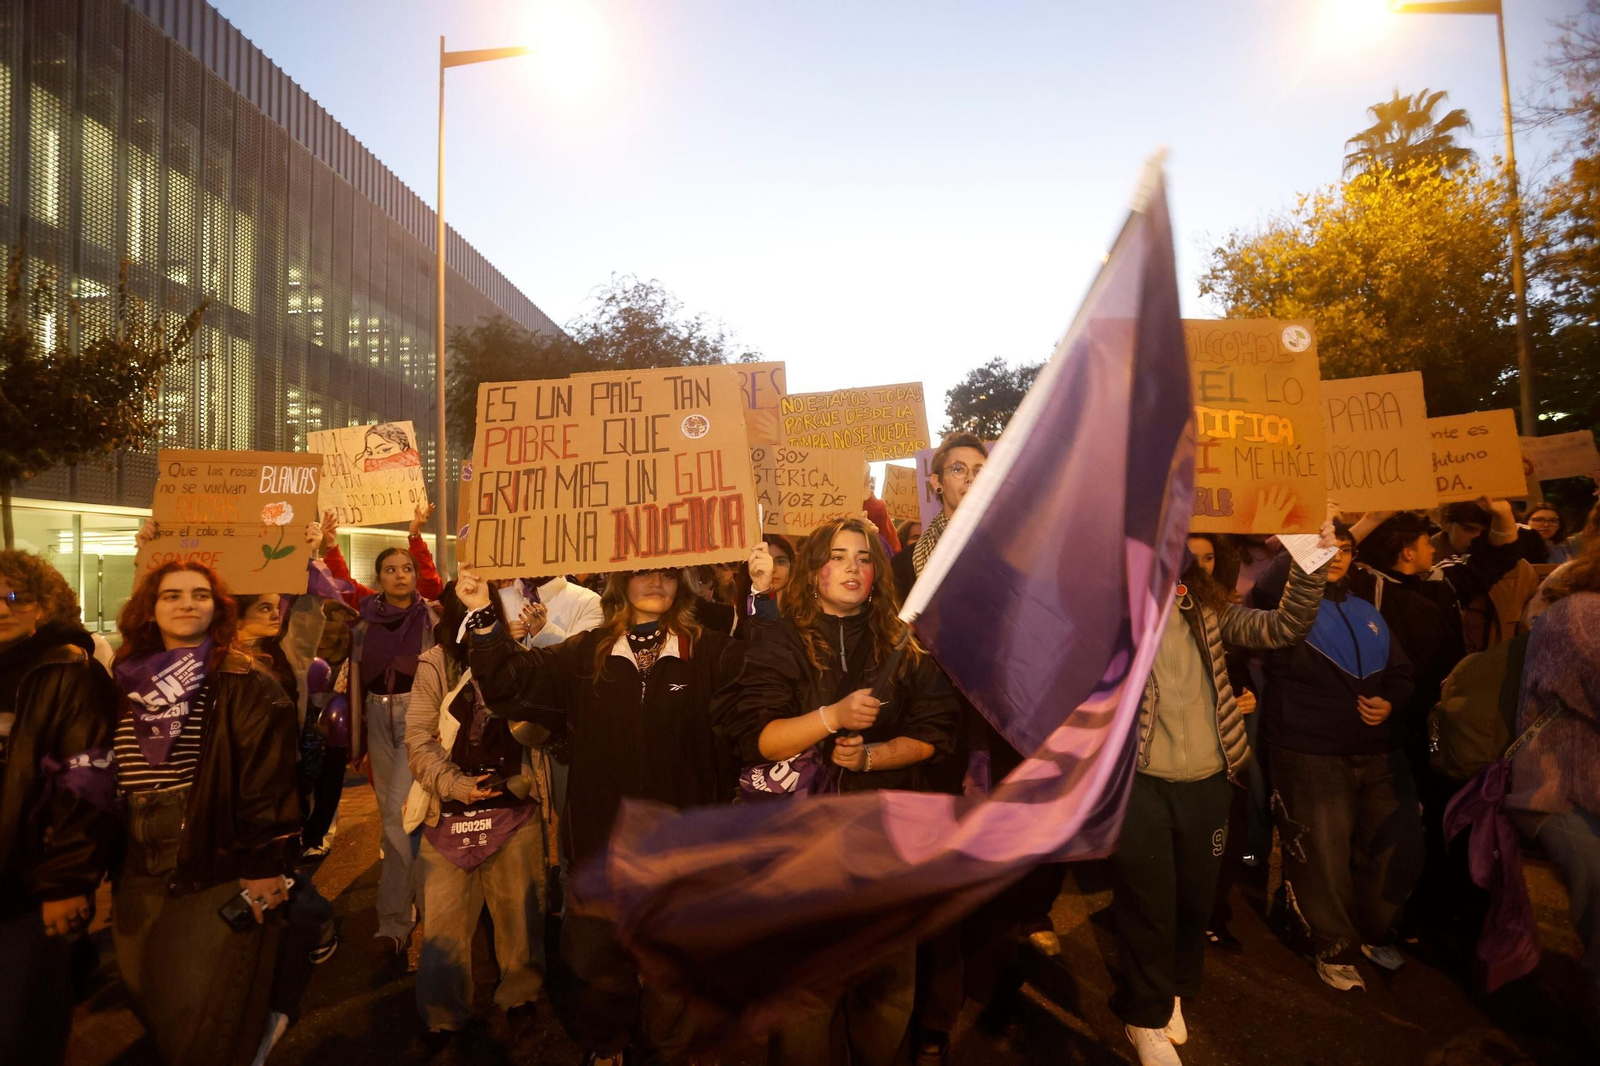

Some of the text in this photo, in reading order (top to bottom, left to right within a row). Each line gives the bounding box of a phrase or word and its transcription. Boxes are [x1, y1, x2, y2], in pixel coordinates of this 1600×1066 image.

[485, 375, 711, 423] ES UN PAÍS TAN
[781, 386, 924, 416] NO ESTAMOS TODAS
[1264, 373, 1304, 406] LO
[784, 404, 915, 435] PORQUE DESDE LA
[1328, 392, 1403, 433] PARA
[483, 413, 670, 468] POBRE QUE
[872, 420, 917, 443] PUEDE
[1467, 425, 1490, 437] es
[776, 446, 809, 464] SOY
[1234, 446, 1265, 481] ME
[160, 481, 246, 495] no se vuelvan
[168, 462, 319, 496] Que las rosas BLANCAS
[478, 449, 736, 516] GRITA MAS UN GOL
[777, 490, 815, 509] VOZ
[179, 525, 190, 537] el
[195, 525, 219, 537] color
[222, 526, 236, 537] de
[474, 493, 747, 569] QUE UNA INJUSTICIA
[450, 817, 493, 835] #UCO25N
